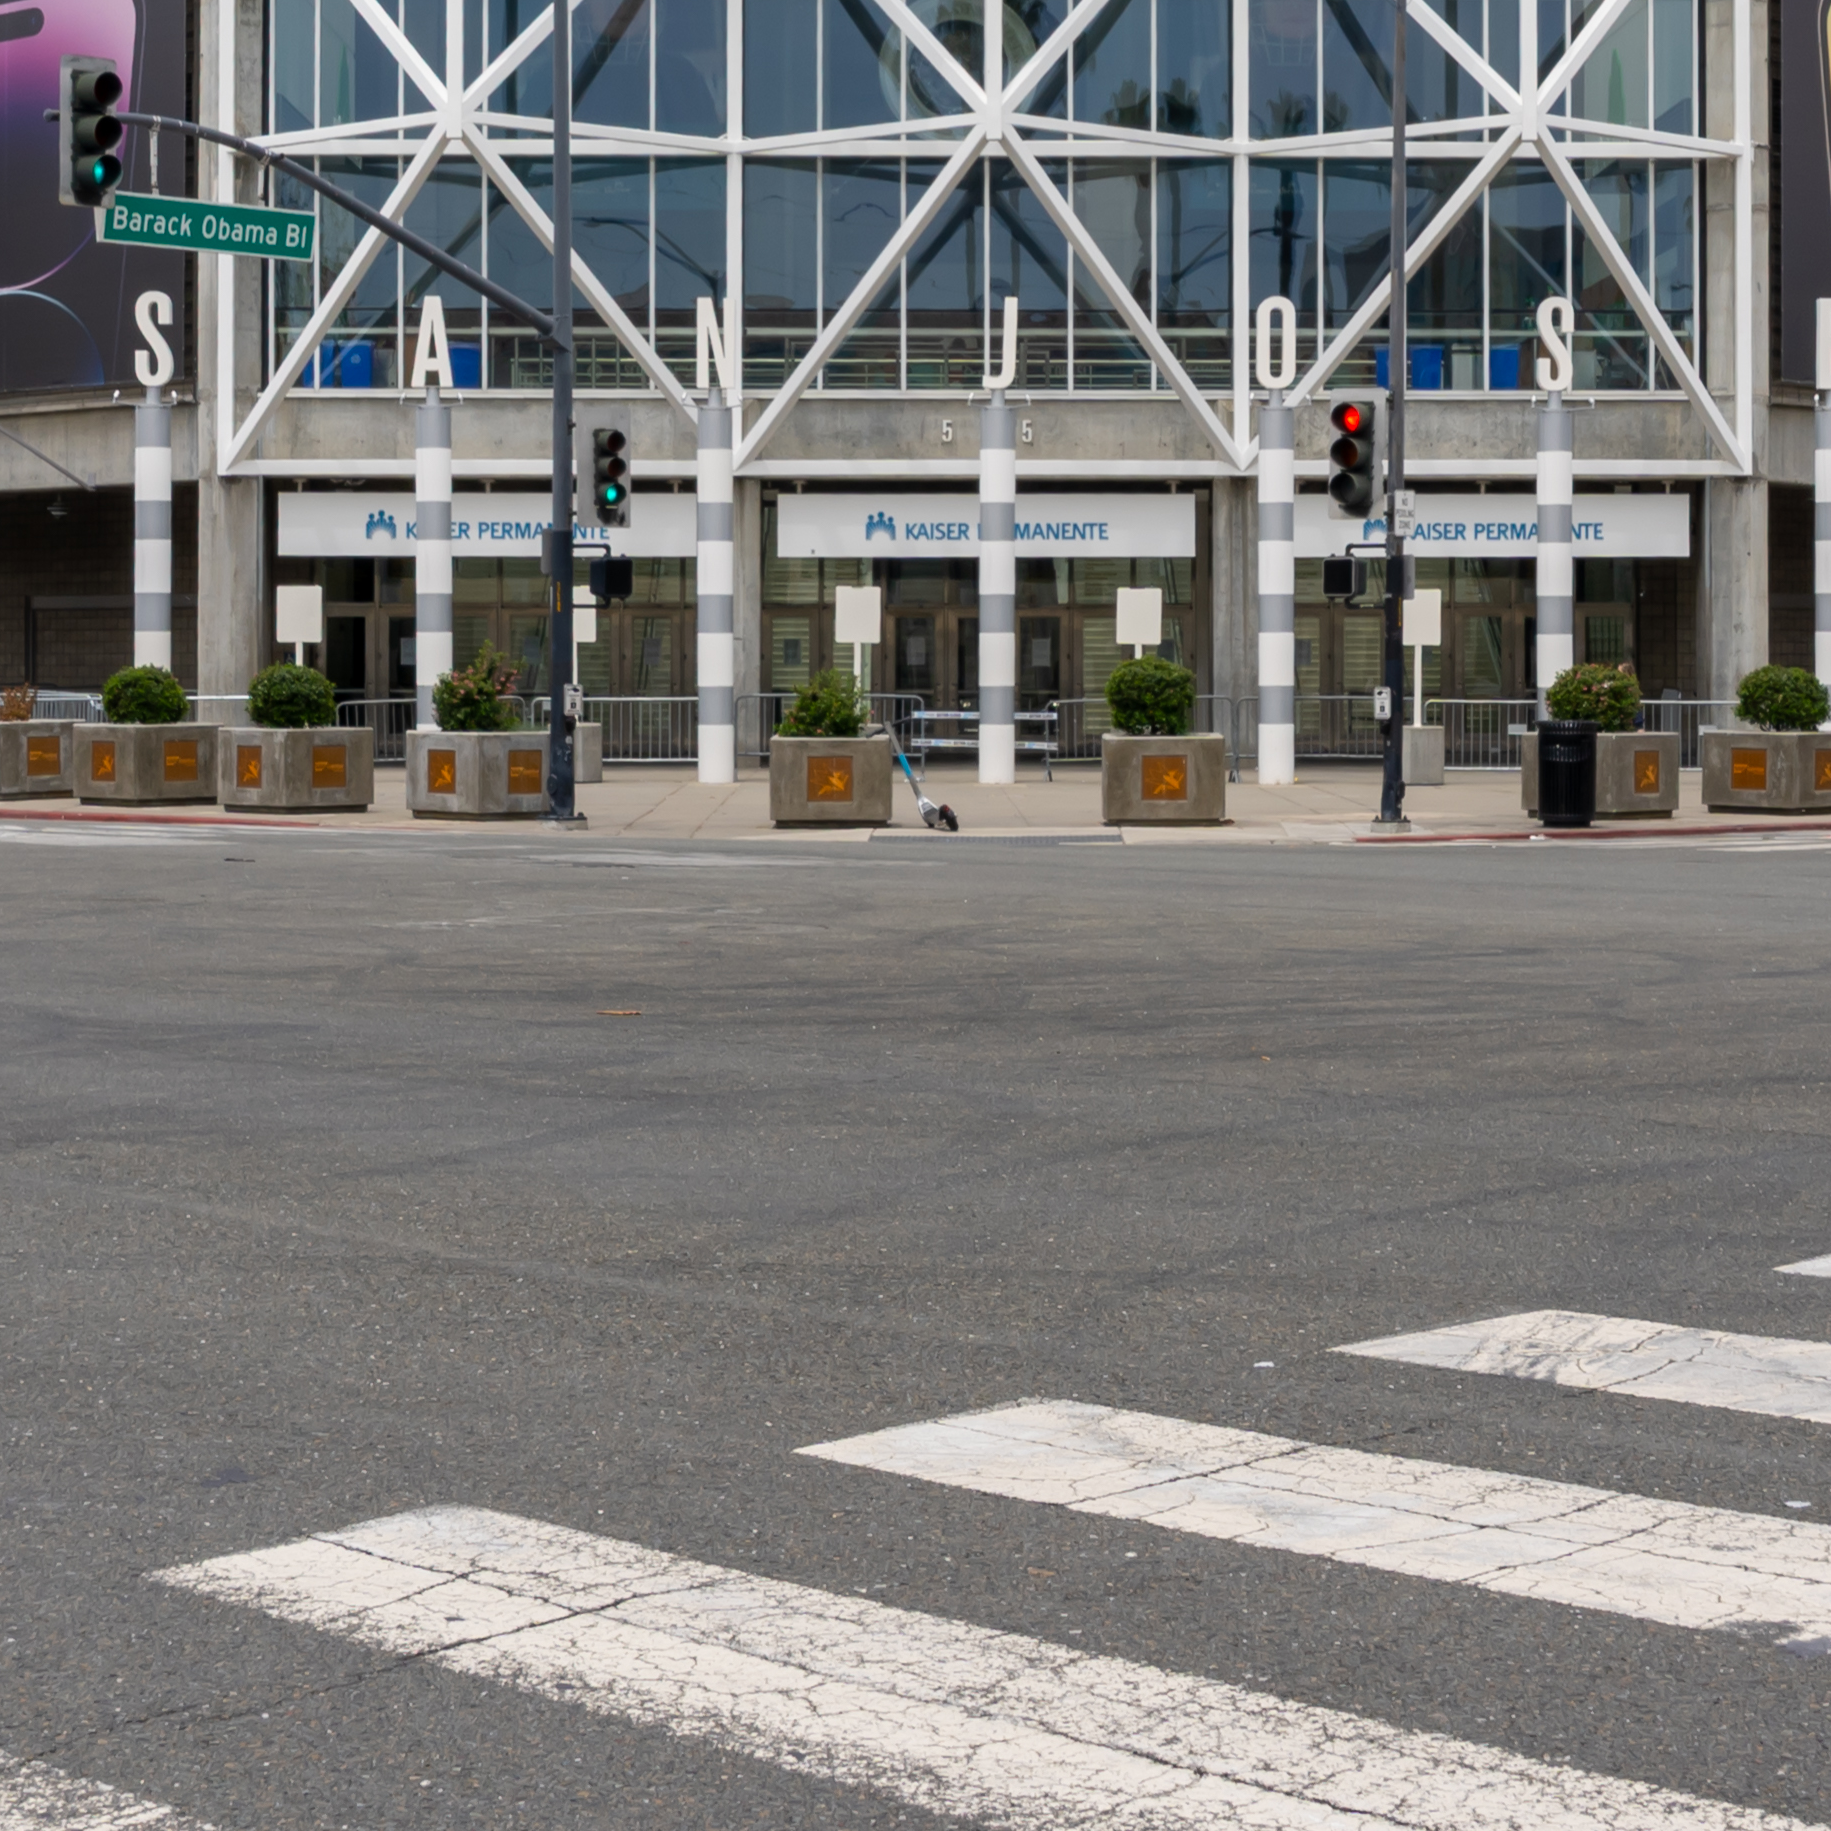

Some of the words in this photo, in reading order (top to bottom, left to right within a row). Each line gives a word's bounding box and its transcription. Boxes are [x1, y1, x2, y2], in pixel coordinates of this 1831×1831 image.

[113, 205, 192, 237] Barack
[202, 215, 277, 245] Obama
[406, 522, 470, 540] KER
[478, 522, 610, 540] PERMANTE
[906, 523, 970, 541] KAISER
[978, 523, 1109, 541] MANENTE
[1406, 523, 1467, 541] AISER
[1474, 523, 1604, 541] PERMANTE
